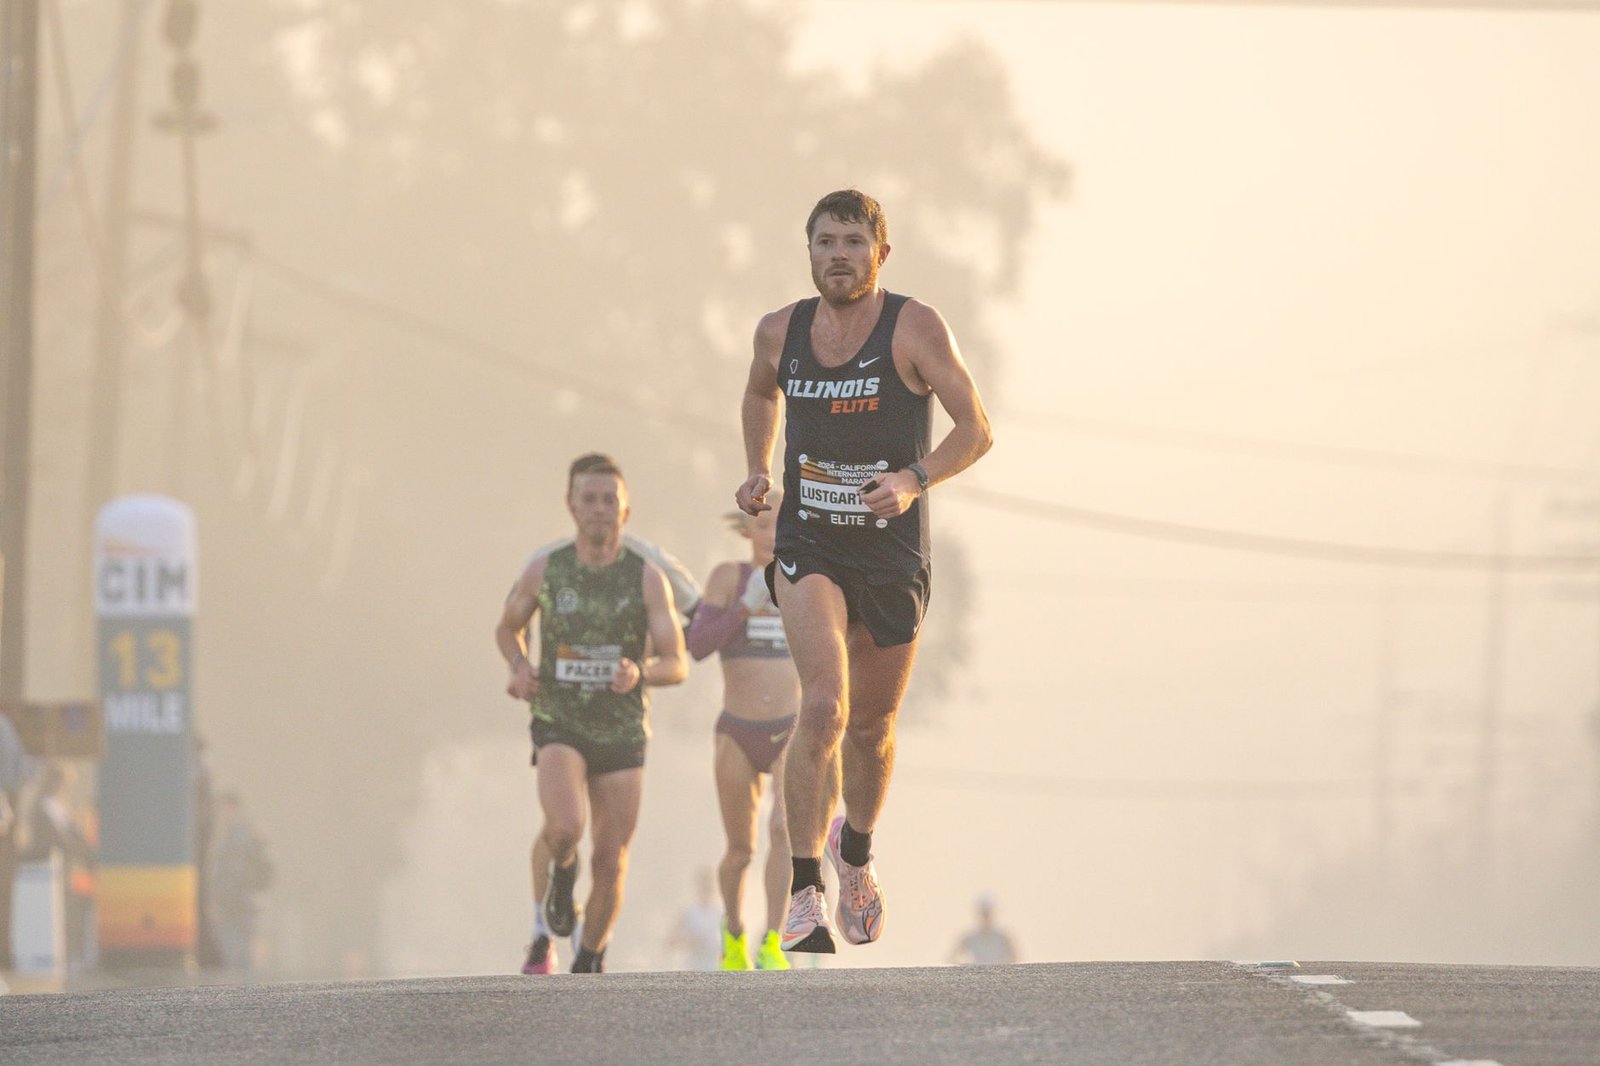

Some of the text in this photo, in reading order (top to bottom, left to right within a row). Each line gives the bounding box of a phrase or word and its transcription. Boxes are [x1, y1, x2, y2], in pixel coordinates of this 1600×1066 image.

[786, 377, 880, 398] ILLINOIS
[830, 398, 880, 414] ELITE
[827, 468, 881, 477] INTERNATIONA
[801, 486, 863, 505] LUSTGART
[830, 514, 865, 525] ELITE
[101, 558, 187, 602] CIM
[110, 630, 181, 688] 13
[565, 662, 612, 676] PACER
[105, 694, 183, 734] MILE
